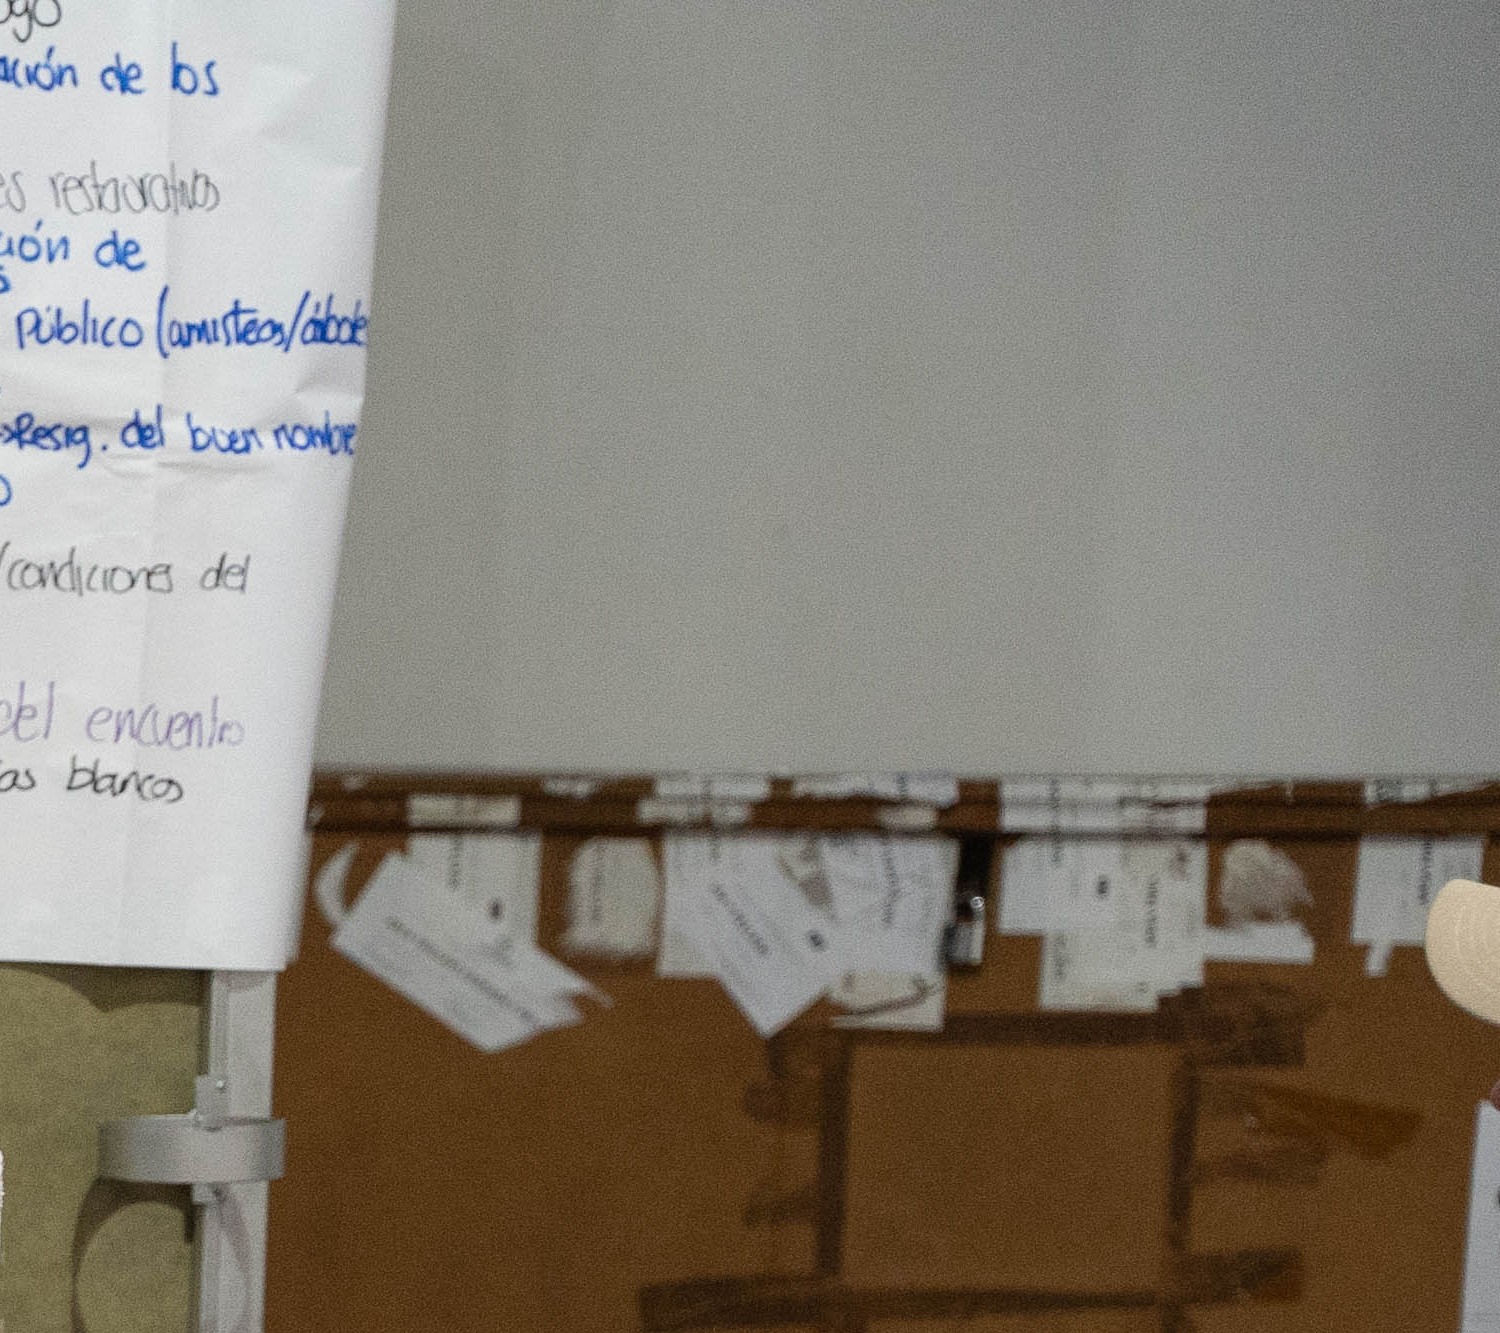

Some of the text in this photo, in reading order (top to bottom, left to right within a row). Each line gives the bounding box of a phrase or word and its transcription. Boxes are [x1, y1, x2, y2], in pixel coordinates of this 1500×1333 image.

[99, 41, 220, 97] de los
[94, 229, 147, 273] de
[120, 404, 165, 450] del
[185, 412, 263, 456] buen
[199, 552, 251, 594] del
